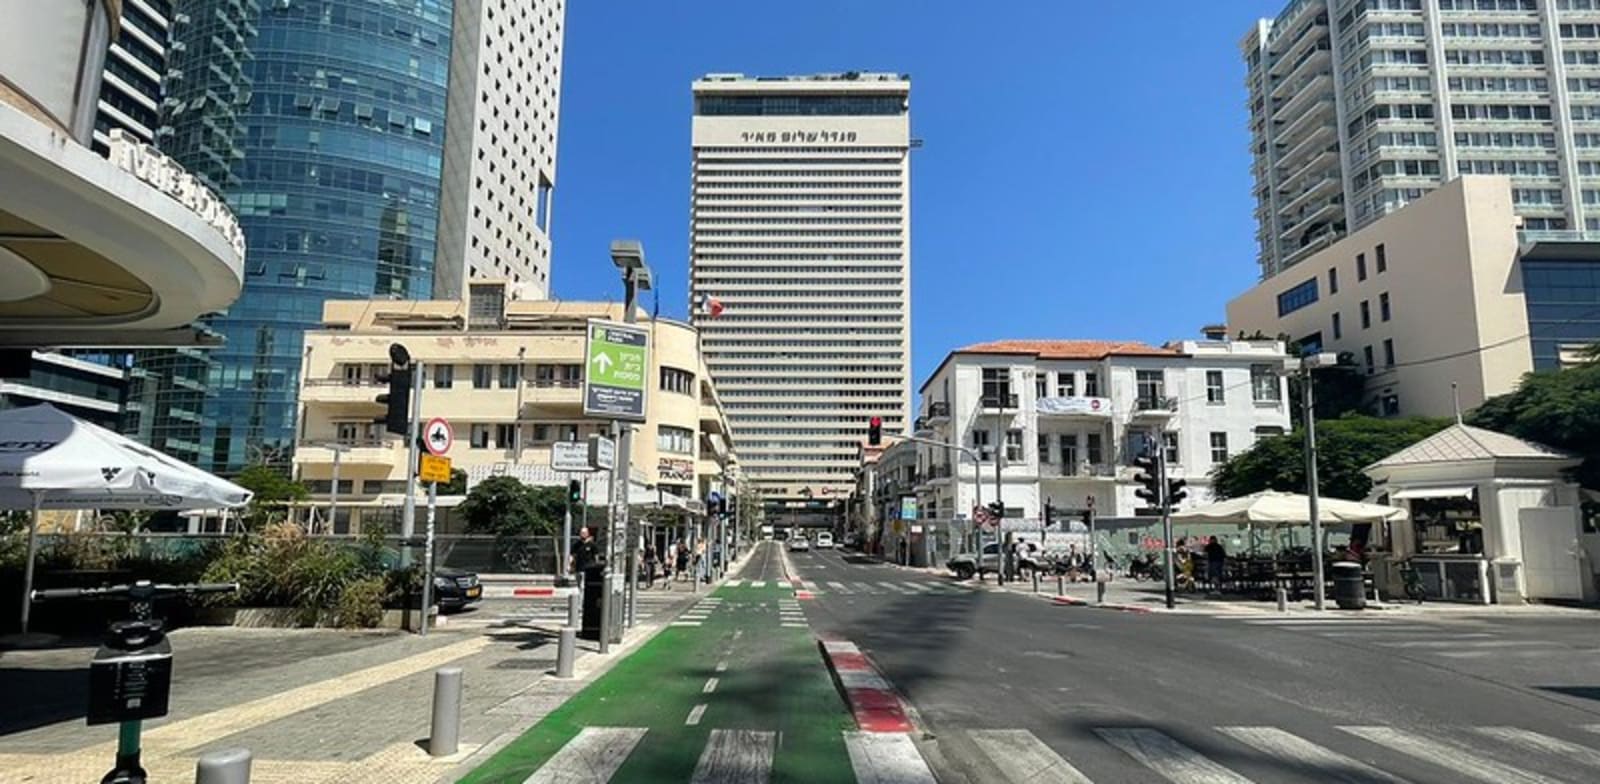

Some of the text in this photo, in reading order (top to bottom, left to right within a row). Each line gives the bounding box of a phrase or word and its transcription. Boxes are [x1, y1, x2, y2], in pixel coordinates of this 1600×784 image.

[741, 130, 857, 142] מגדל שלום מאיר
